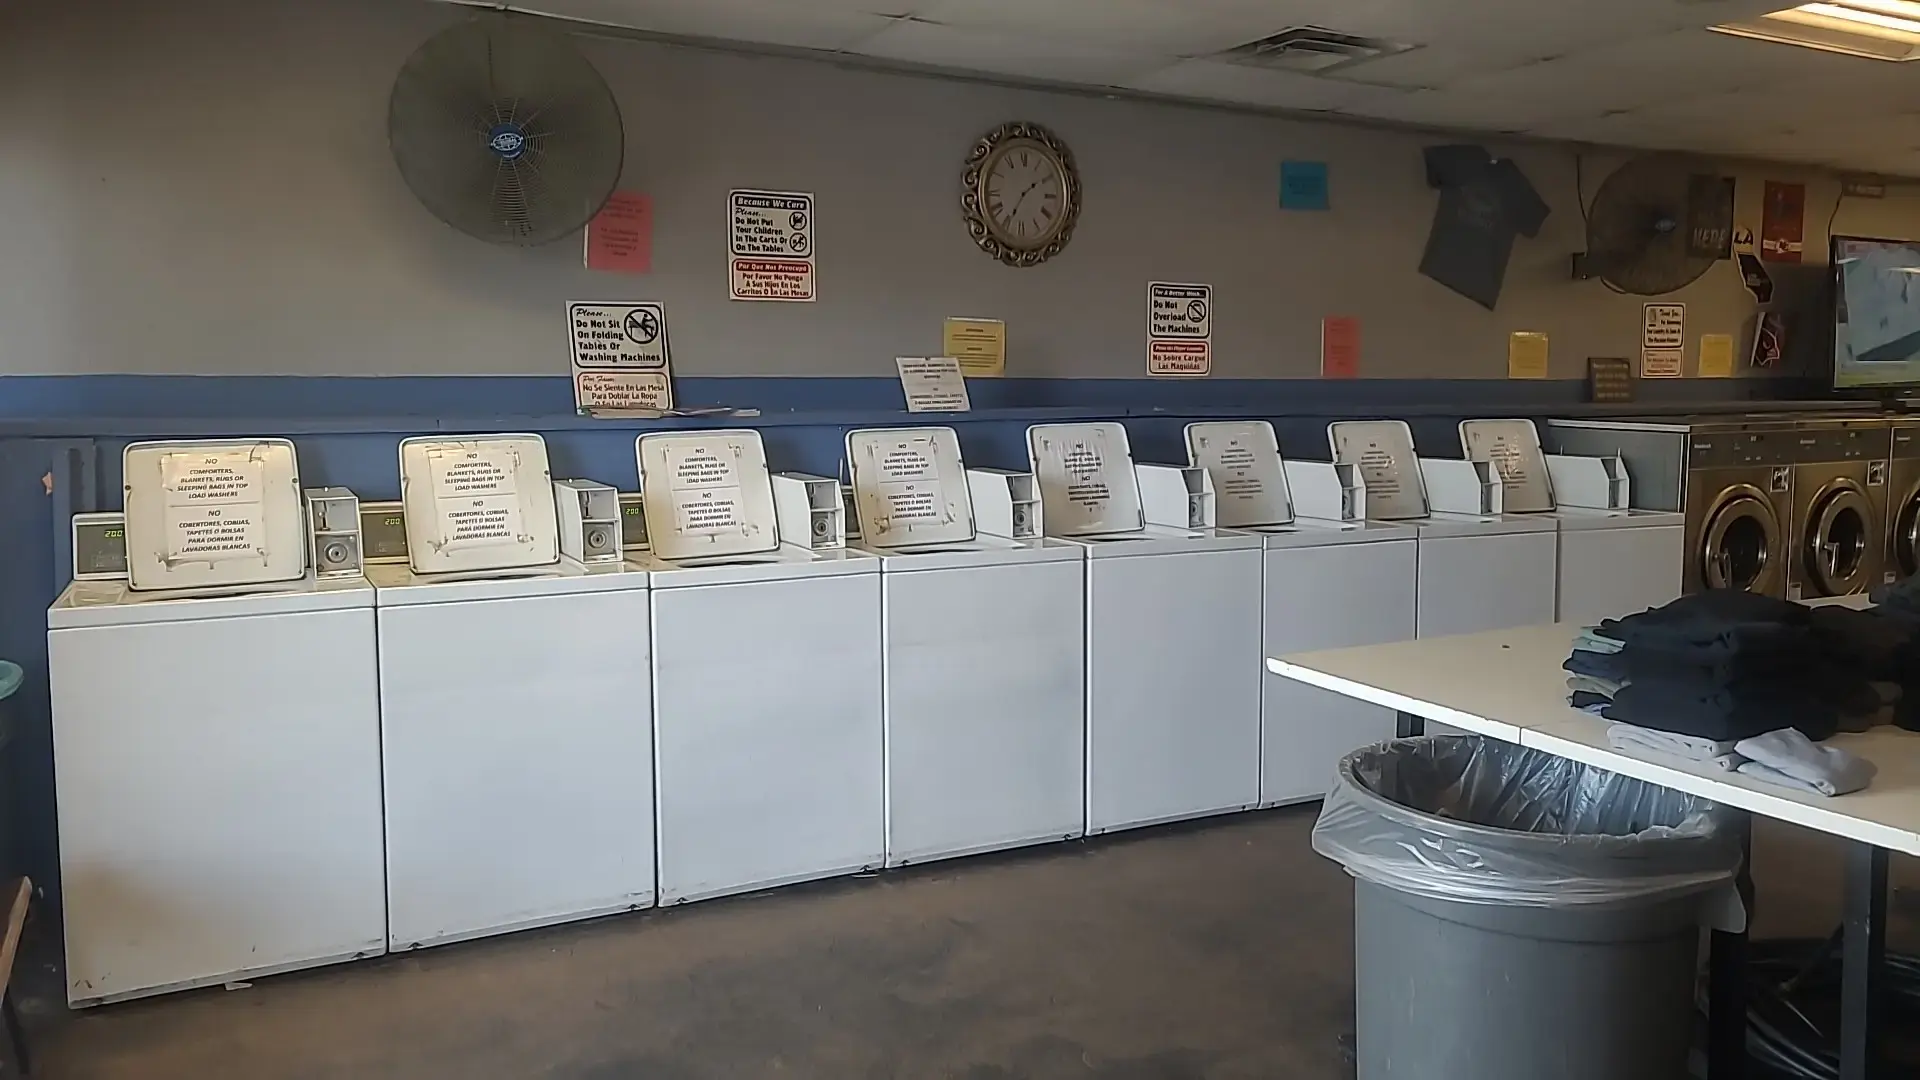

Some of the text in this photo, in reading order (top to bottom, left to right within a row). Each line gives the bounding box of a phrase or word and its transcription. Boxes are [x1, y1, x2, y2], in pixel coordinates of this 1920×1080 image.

[738, 198, 770, 206] Because
[754, 227, 782, 235] Children
[1734, 228, 1753, 244] LA
[1154, 324, 1199, 333] The Machines
[592, 331, 624, 340] Folding
[580, 353, 617, 362] Washing
